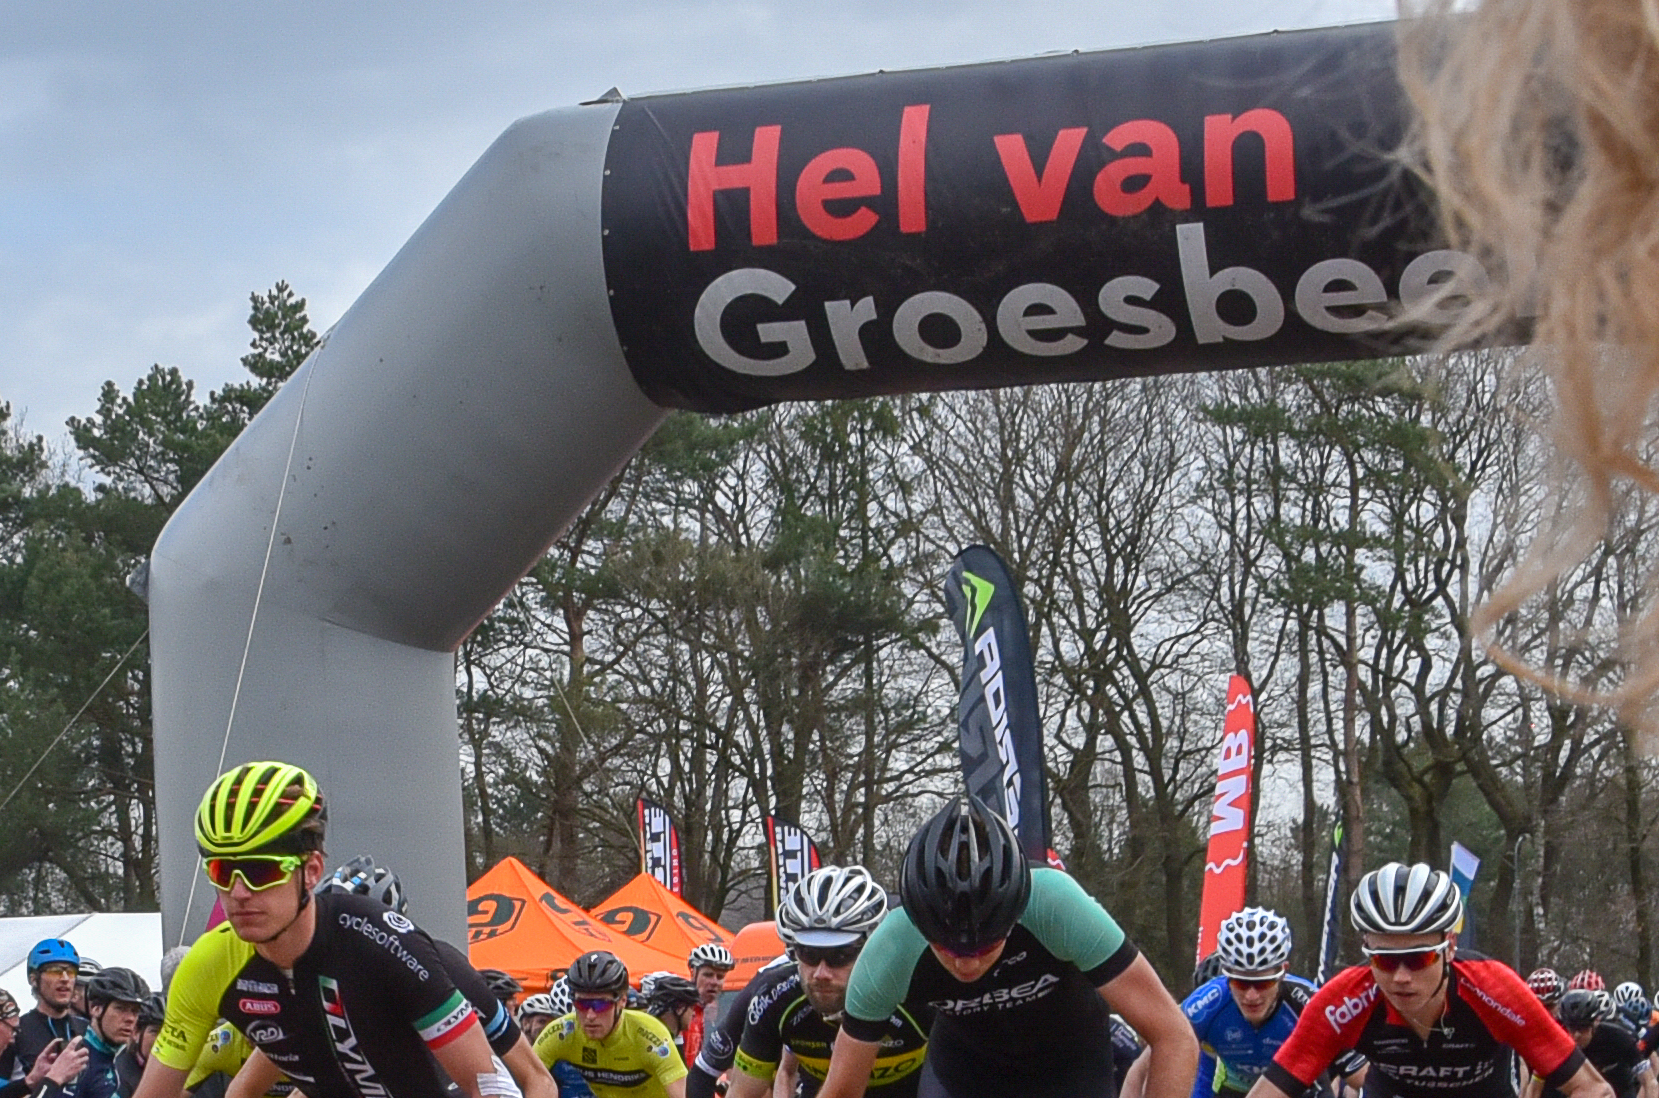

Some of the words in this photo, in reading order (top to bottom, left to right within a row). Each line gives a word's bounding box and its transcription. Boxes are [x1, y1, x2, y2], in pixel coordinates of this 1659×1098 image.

[688, 103, 931, 252] Hel
[993, 107, 1298, 224] van
[693, 221, 1512, 378] Groesbee
[338, 912, 430, 982] cyclesoftware
[245, 1001, 276, 1012] ABUS
[927, 972, 1060, 1012] ORBEA
[1186, 987, 1220, 1018] KMC
[1324, 983, 1379, 1035] fabri
